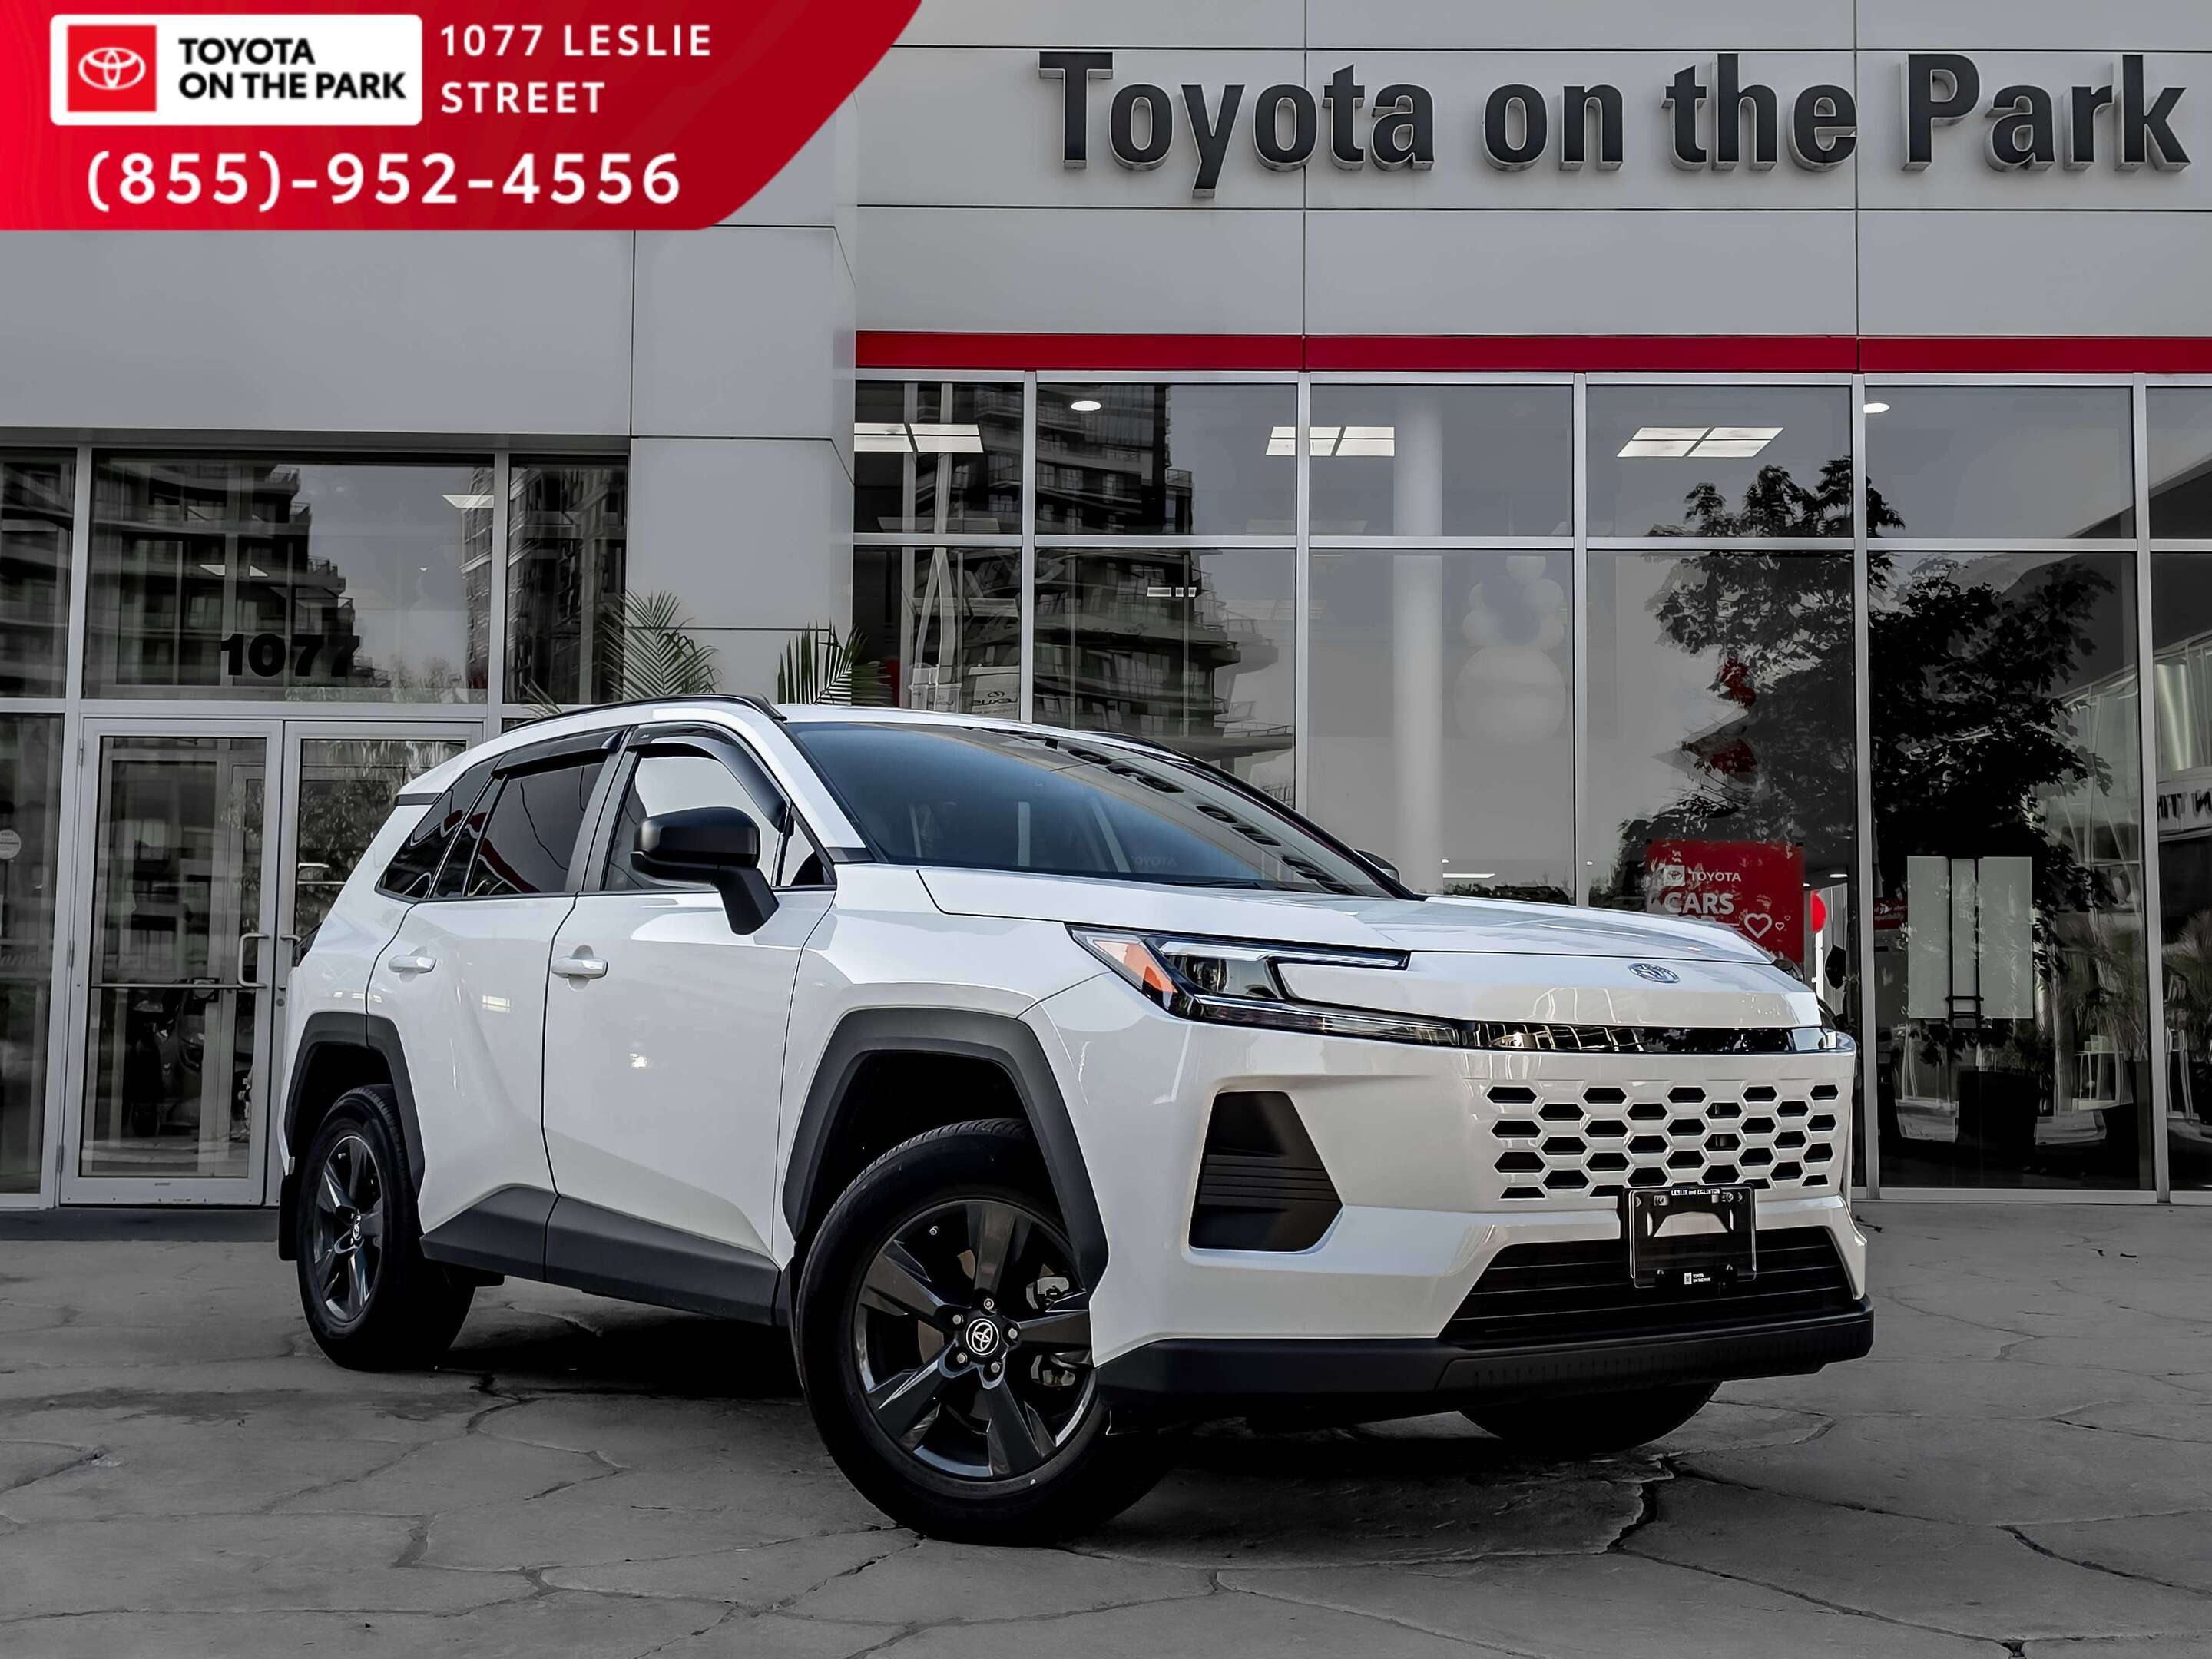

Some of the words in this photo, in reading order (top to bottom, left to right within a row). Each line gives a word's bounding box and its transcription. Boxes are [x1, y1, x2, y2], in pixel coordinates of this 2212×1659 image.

[1038, 51, 1435, 198] Toyota
[1482, 83, 1623, 172] on
[1661, 53, 1859, 172] the
[1900, 53, 2193, 172] Park
[1690, 872, 1742, 882] TOYOTA
[1664, 892, 1734, 915] CARS
